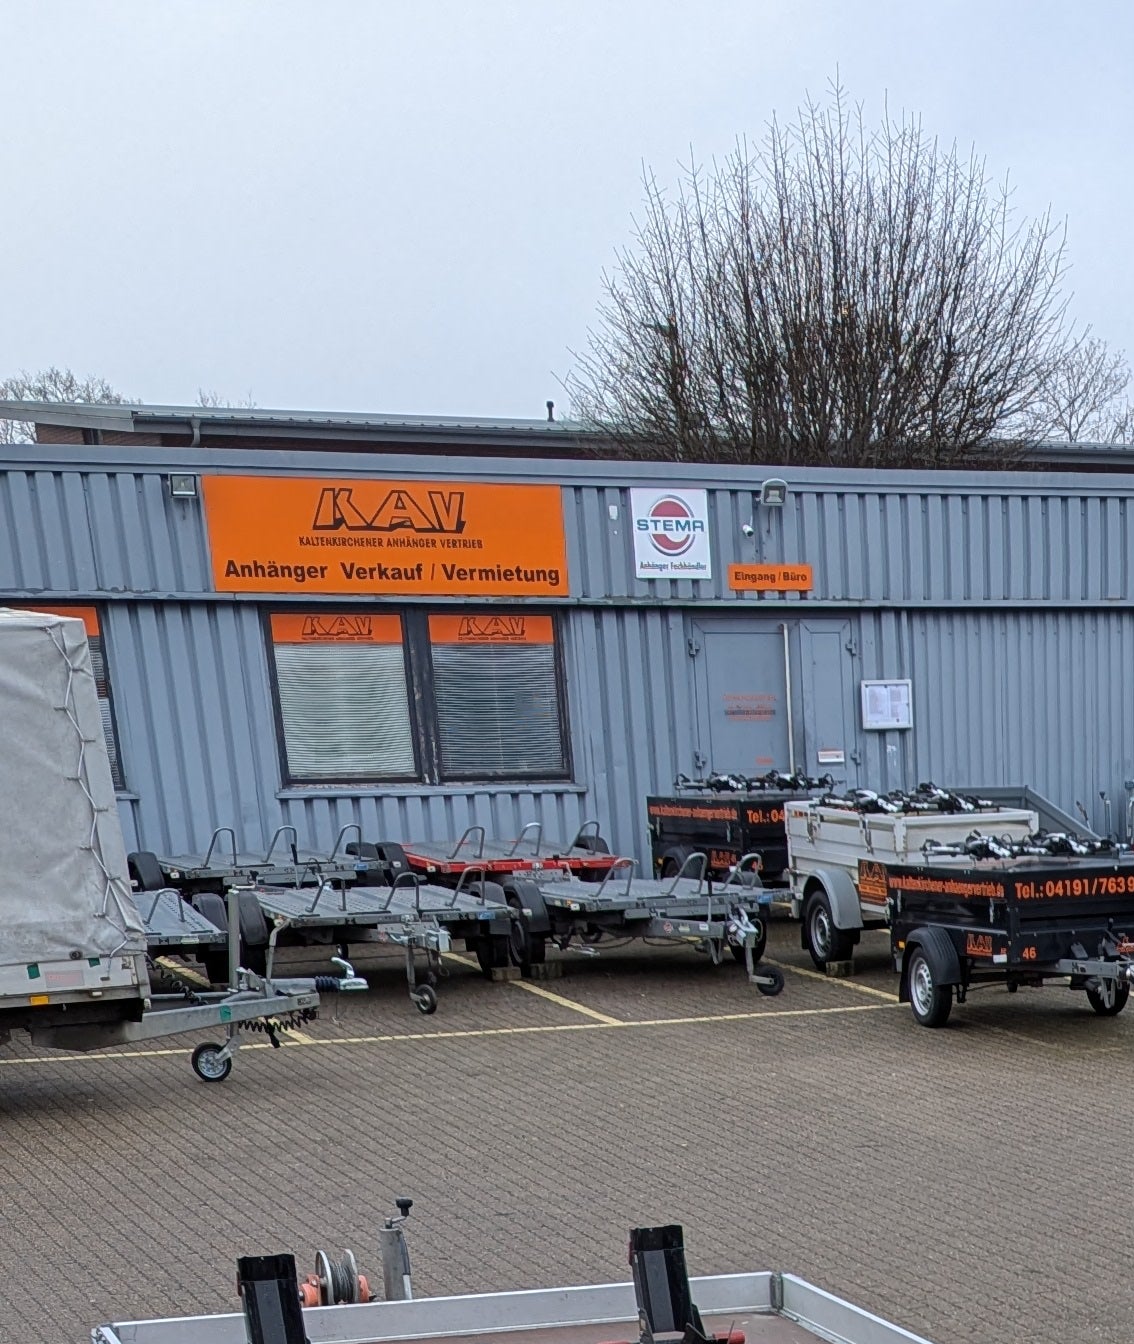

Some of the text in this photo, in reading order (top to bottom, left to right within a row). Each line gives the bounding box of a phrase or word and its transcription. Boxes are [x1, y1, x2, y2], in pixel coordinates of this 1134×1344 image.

[312, 487, 467, 534] KAV
[636, 519, 705, 532] STEMA
[299, 536, 483, 549] KALTENKIRCHENER ANHÄNGER VERTRIEB
[640, 561, 669, 571] Anhänger
[225, 560, 560, 587] Anhänger Verkauf / Vermietung
[734, 571, 776, 583] Eingang
[783, 571, 807, 581] Büro
[302, 615, 373, 636] KAV
[458, 616, 526, 637] KAV
[1022, 946, 1037, 959] 46
